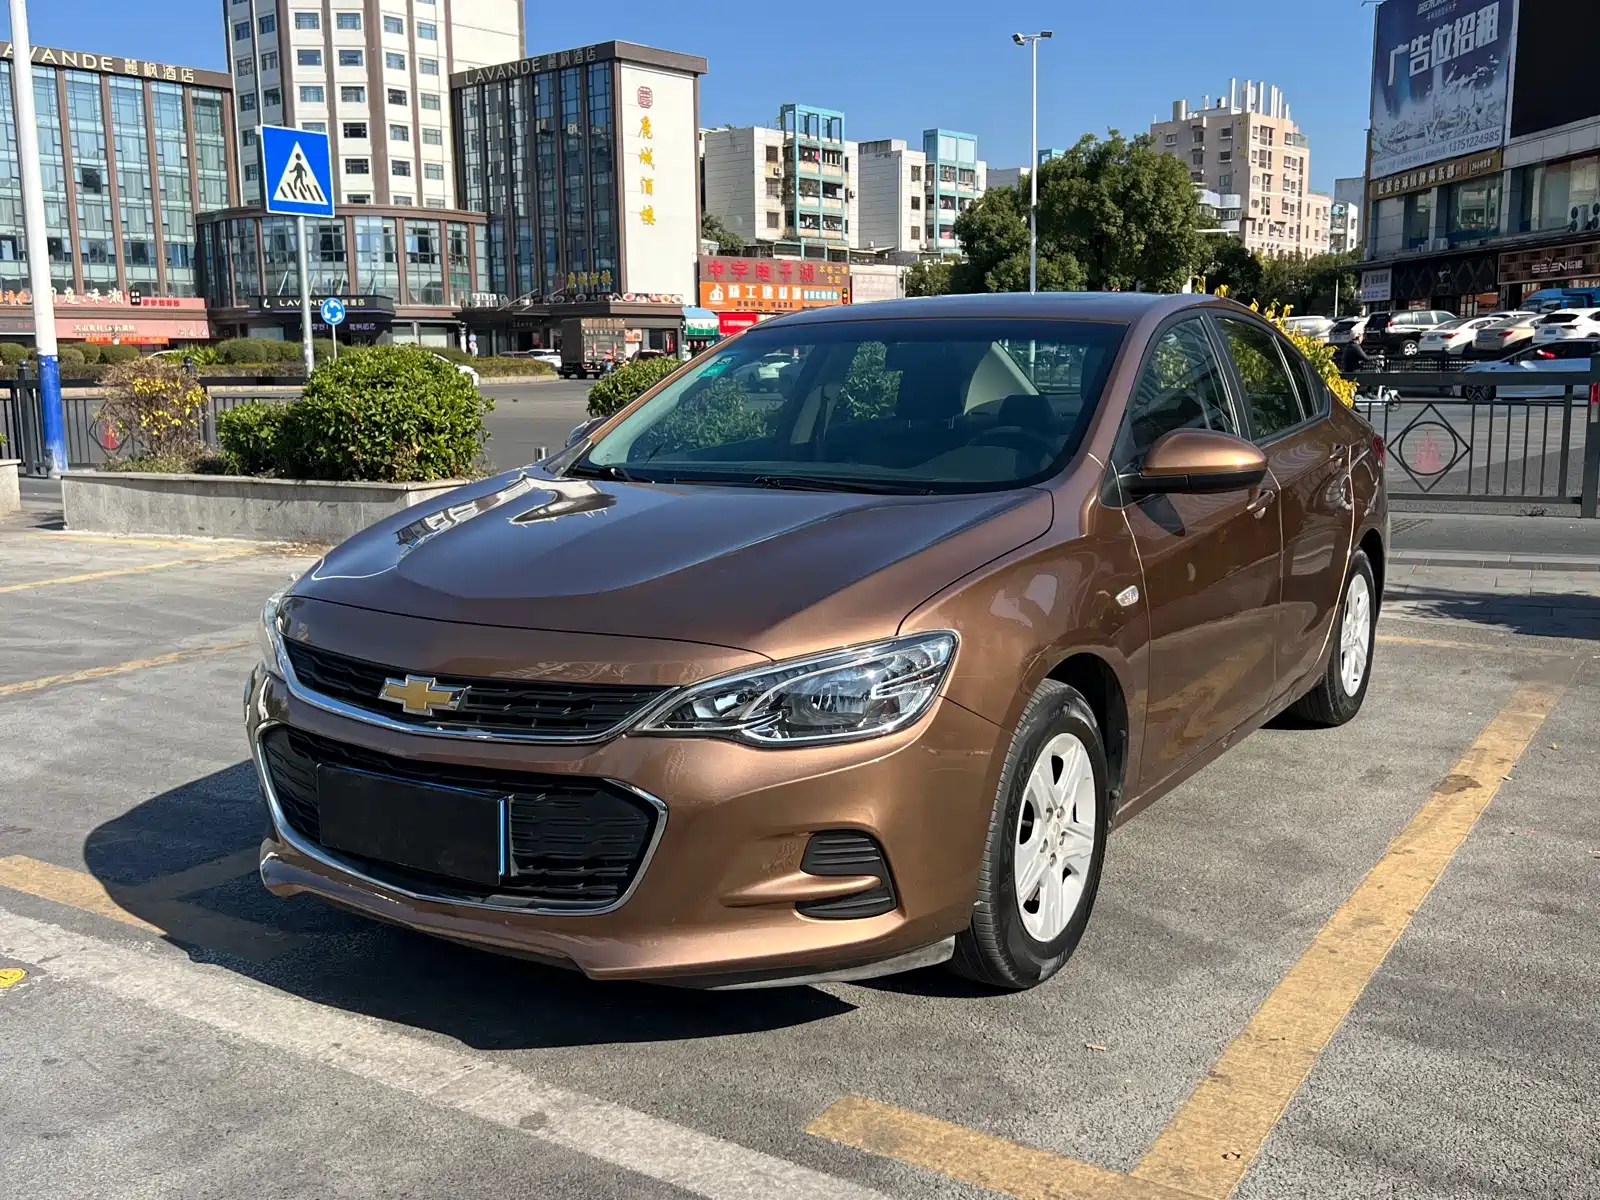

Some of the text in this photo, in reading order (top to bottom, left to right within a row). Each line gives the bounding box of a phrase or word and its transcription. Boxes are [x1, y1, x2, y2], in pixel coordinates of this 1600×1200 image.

[465, 57, 541, 85] LAVANDE
[1388, 1, 1500, 86] 广告位招租
